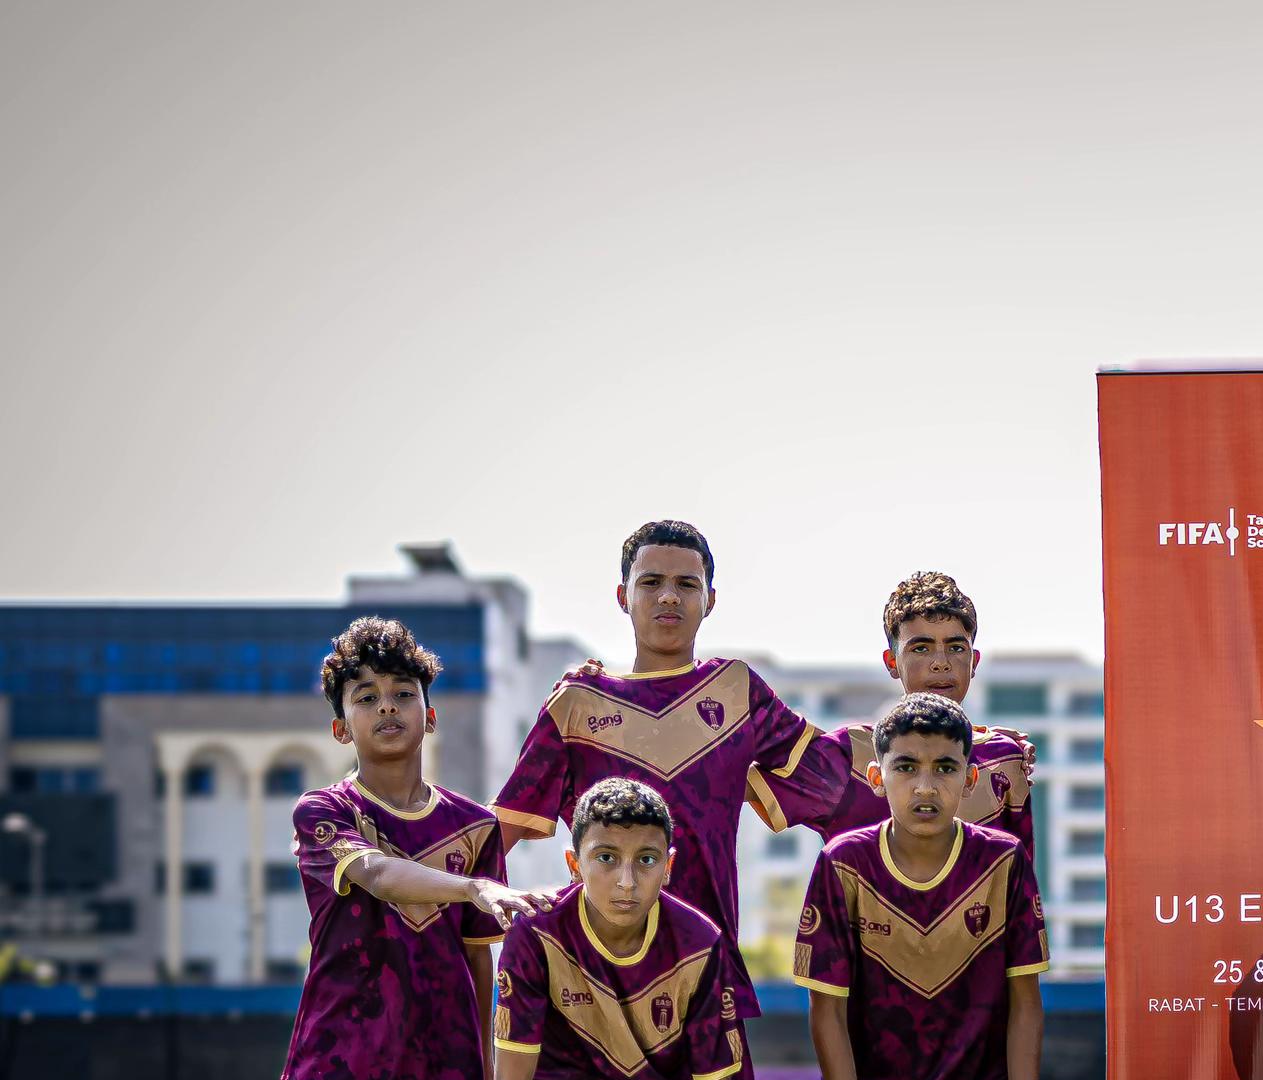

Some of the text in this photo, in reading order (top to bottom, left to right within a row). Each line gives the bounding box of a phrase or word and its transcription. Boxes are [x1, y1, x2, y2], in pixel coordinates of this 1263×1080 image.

[1159, 522, 1224, 545] FIFA
[1155, 894, 1224, 923] U13
[1213, 960, 1243, 983] 25
[1148, 997, 1205, 1012] RABAT
